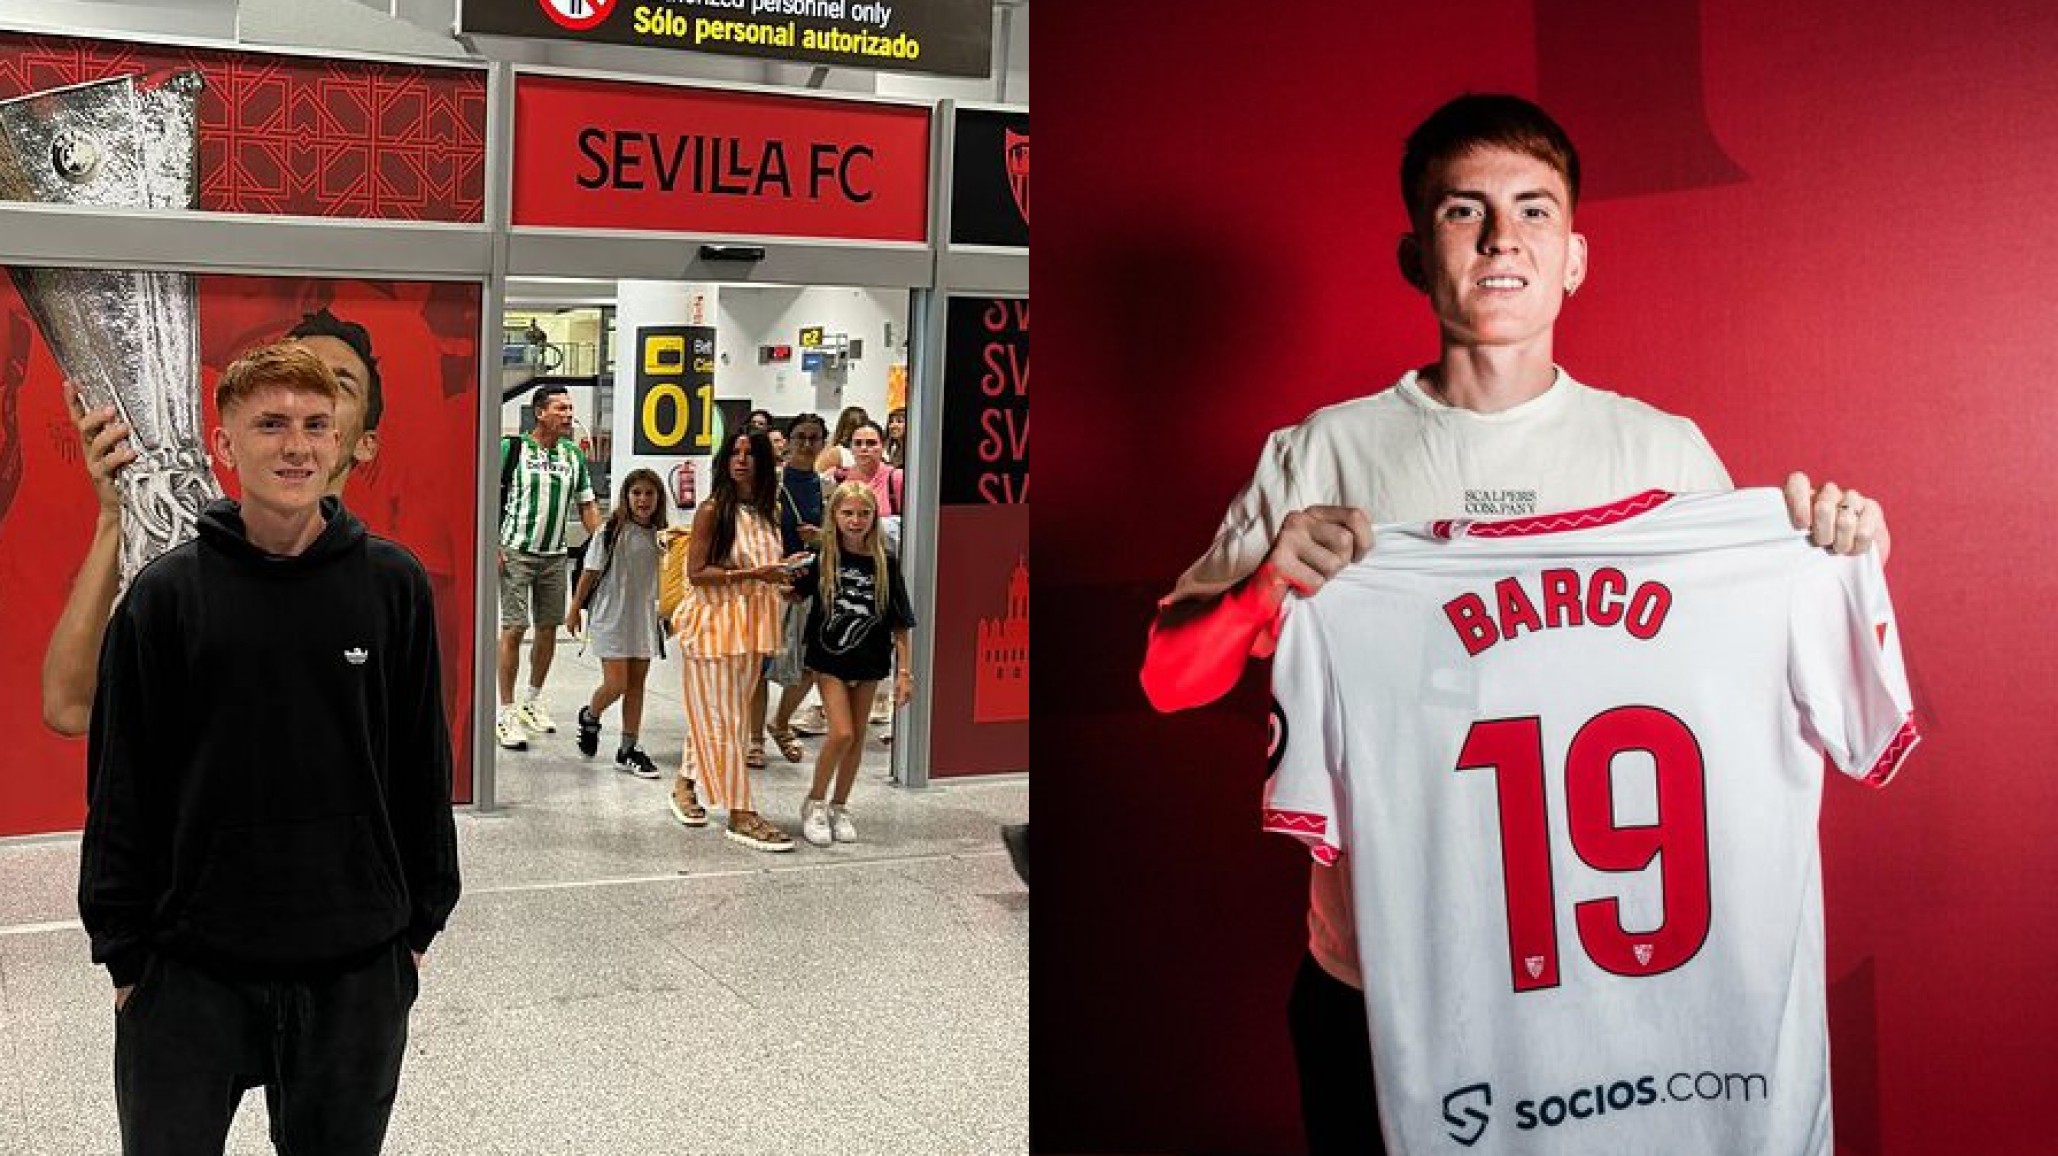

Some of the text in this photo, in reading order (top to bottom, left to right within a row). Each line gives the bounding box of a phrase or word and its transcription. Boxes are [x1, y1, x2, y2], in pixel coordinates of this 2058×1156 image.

[633, 6, 920, 60] Sólo personal autorizado
[751, 0, 892, 28] personnel only
[576, 127, 875, 203] SEVILLA FC
[642, 383, 713, 447] 01
[1442, 567, 1673, 657] BARCO
[1455, 704, 1711, 993] 19
